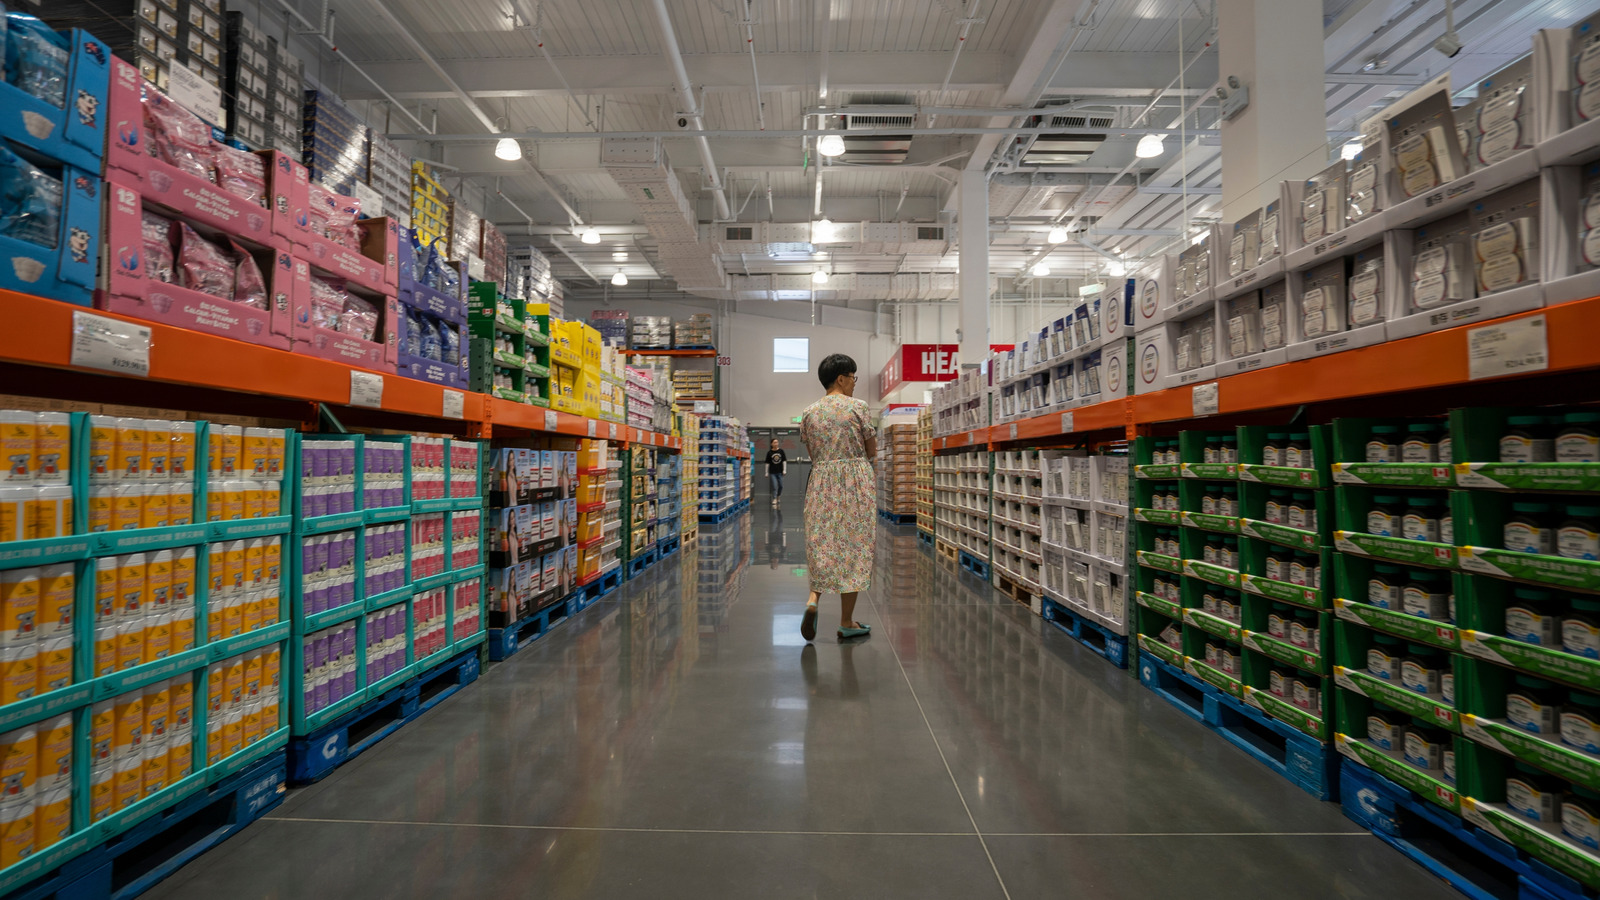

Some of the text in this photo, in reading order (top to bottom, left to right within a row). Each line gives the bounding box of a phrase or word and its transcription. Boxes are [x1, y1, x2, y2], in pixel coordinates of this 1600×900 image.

[117, 62, 137, 83] 12
[116, 187, 136, 207] 12
[296, 262, 307, 276] 12
[717, 356, 731, 366] 303
